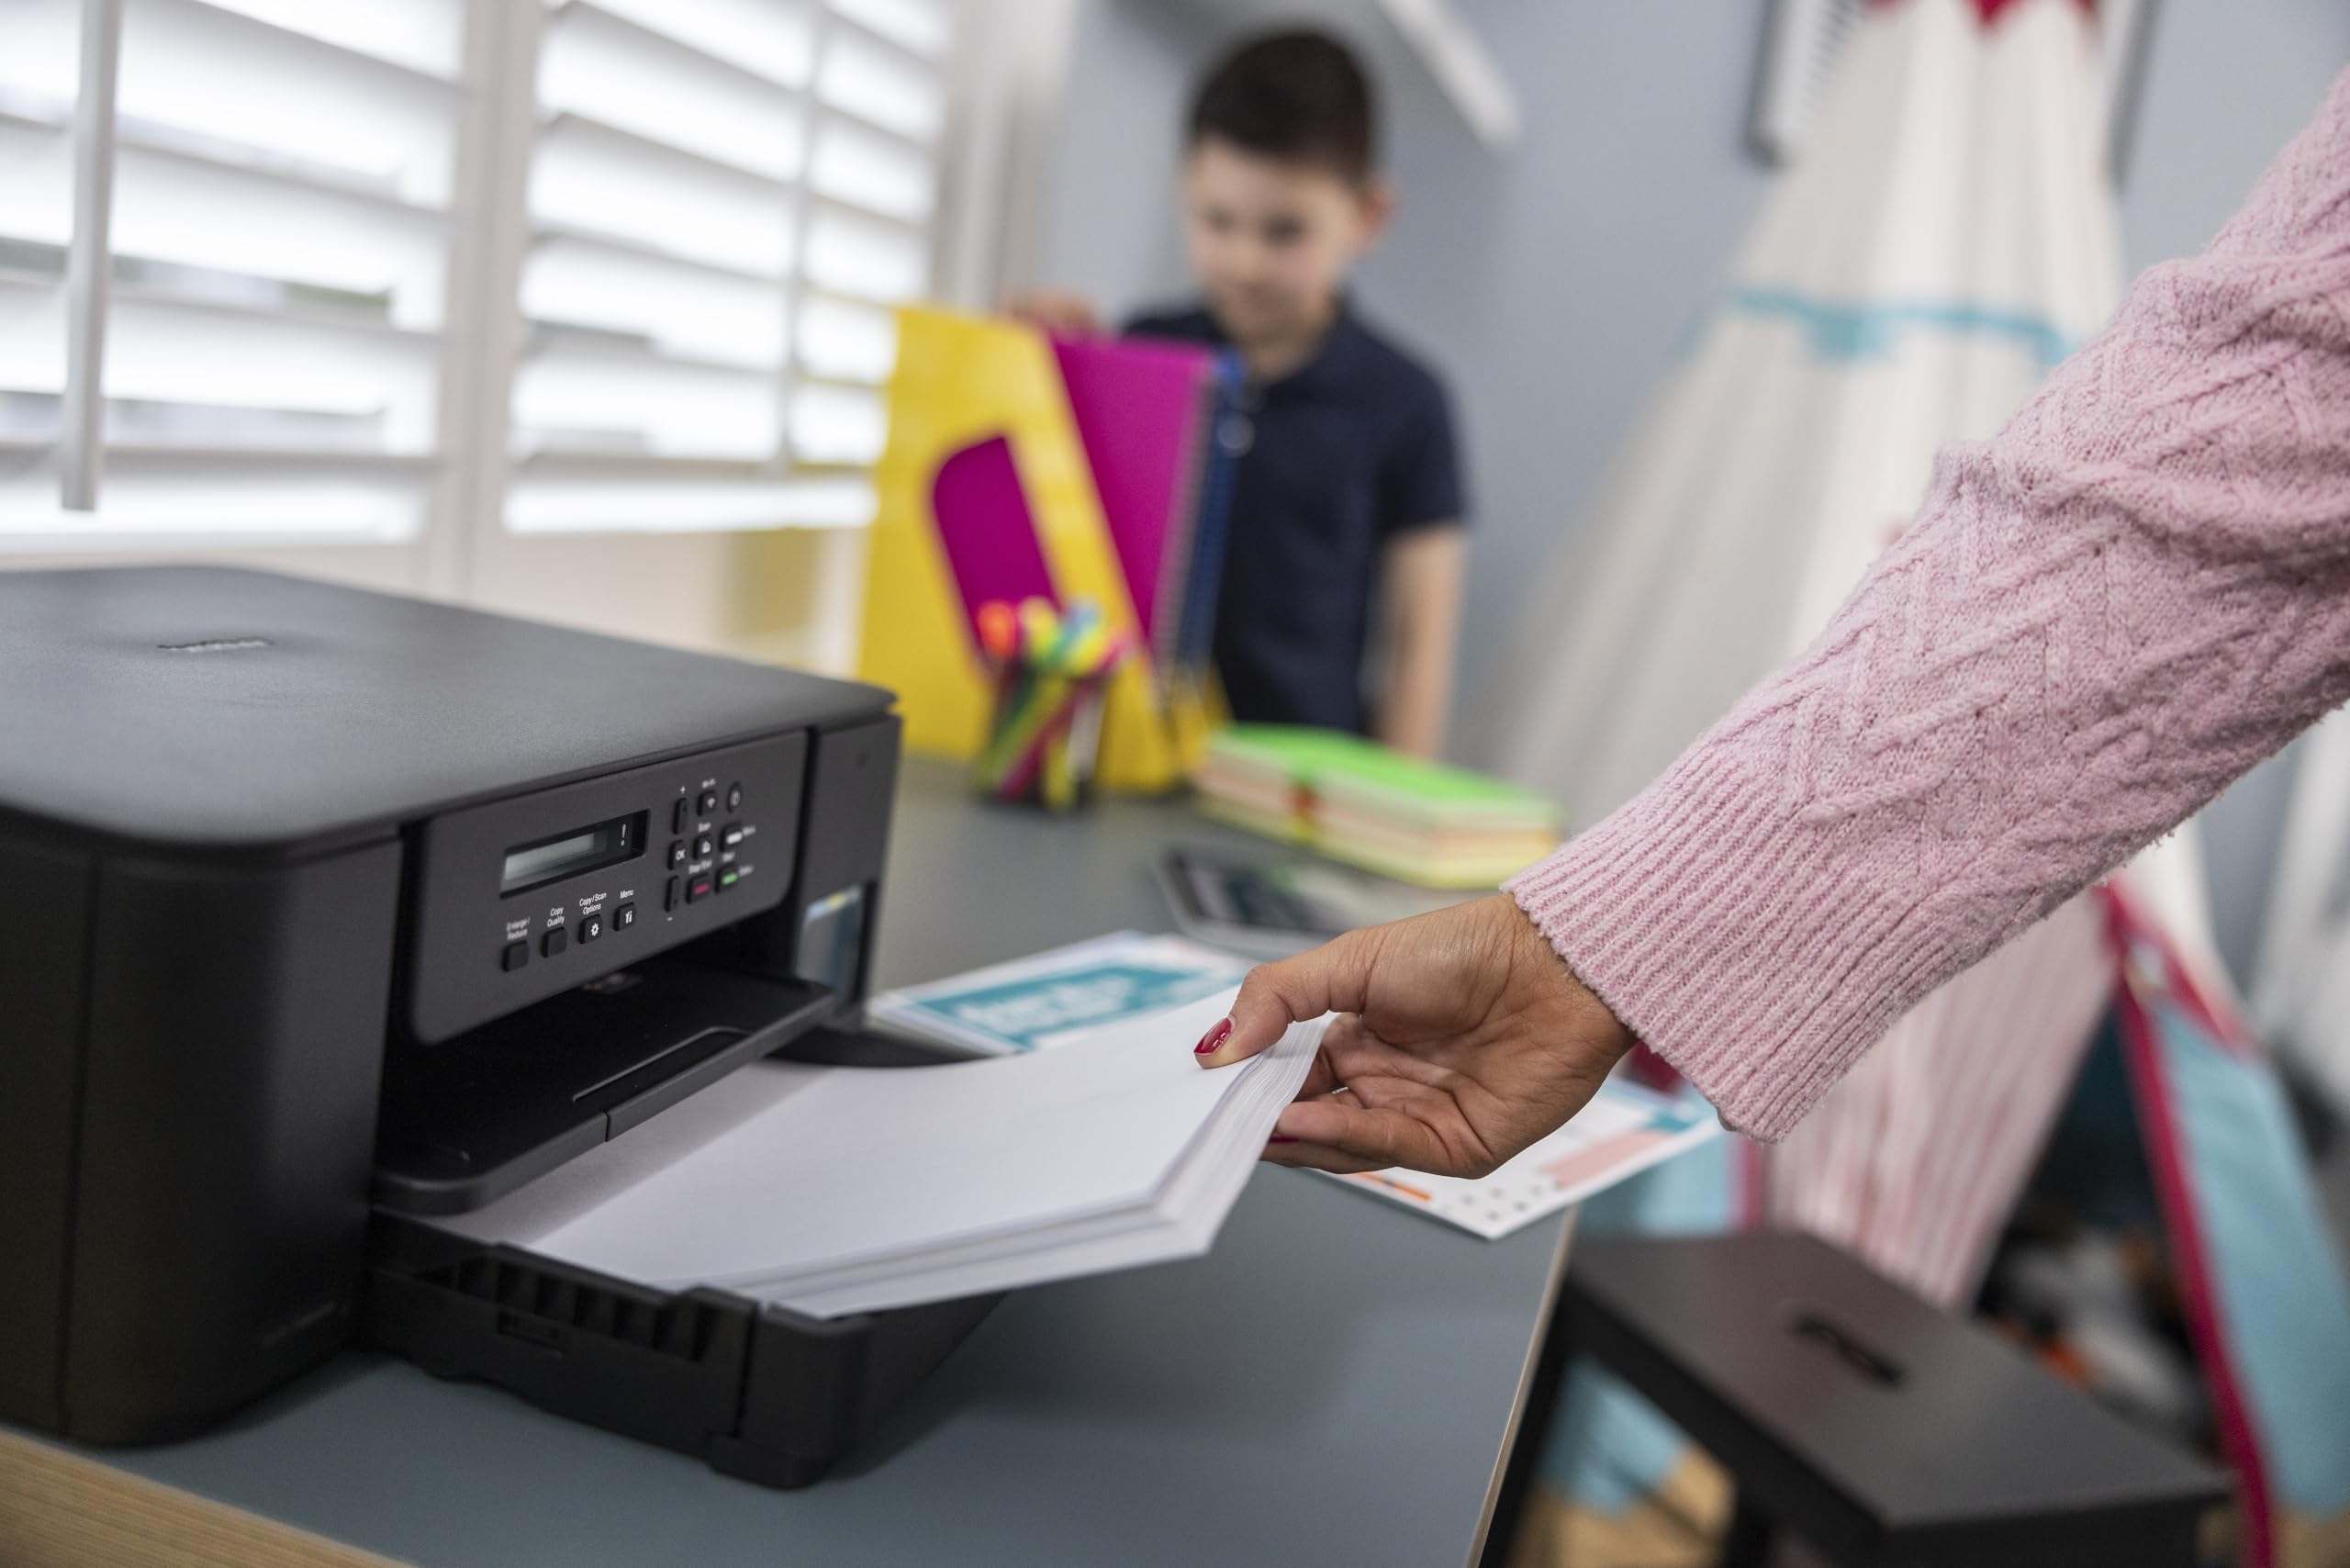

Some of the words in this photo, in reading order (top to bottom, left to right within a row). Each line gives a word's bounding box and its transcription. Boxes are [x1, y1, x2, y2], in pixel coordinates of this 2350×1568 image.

[676, 850, 686, 861] OK
[620, 890, 634, 899] Menu
[551, 907, 564, 916] Copy
[583, 903, 602, 915] Options
[547, 916, 565, 927] Quality
